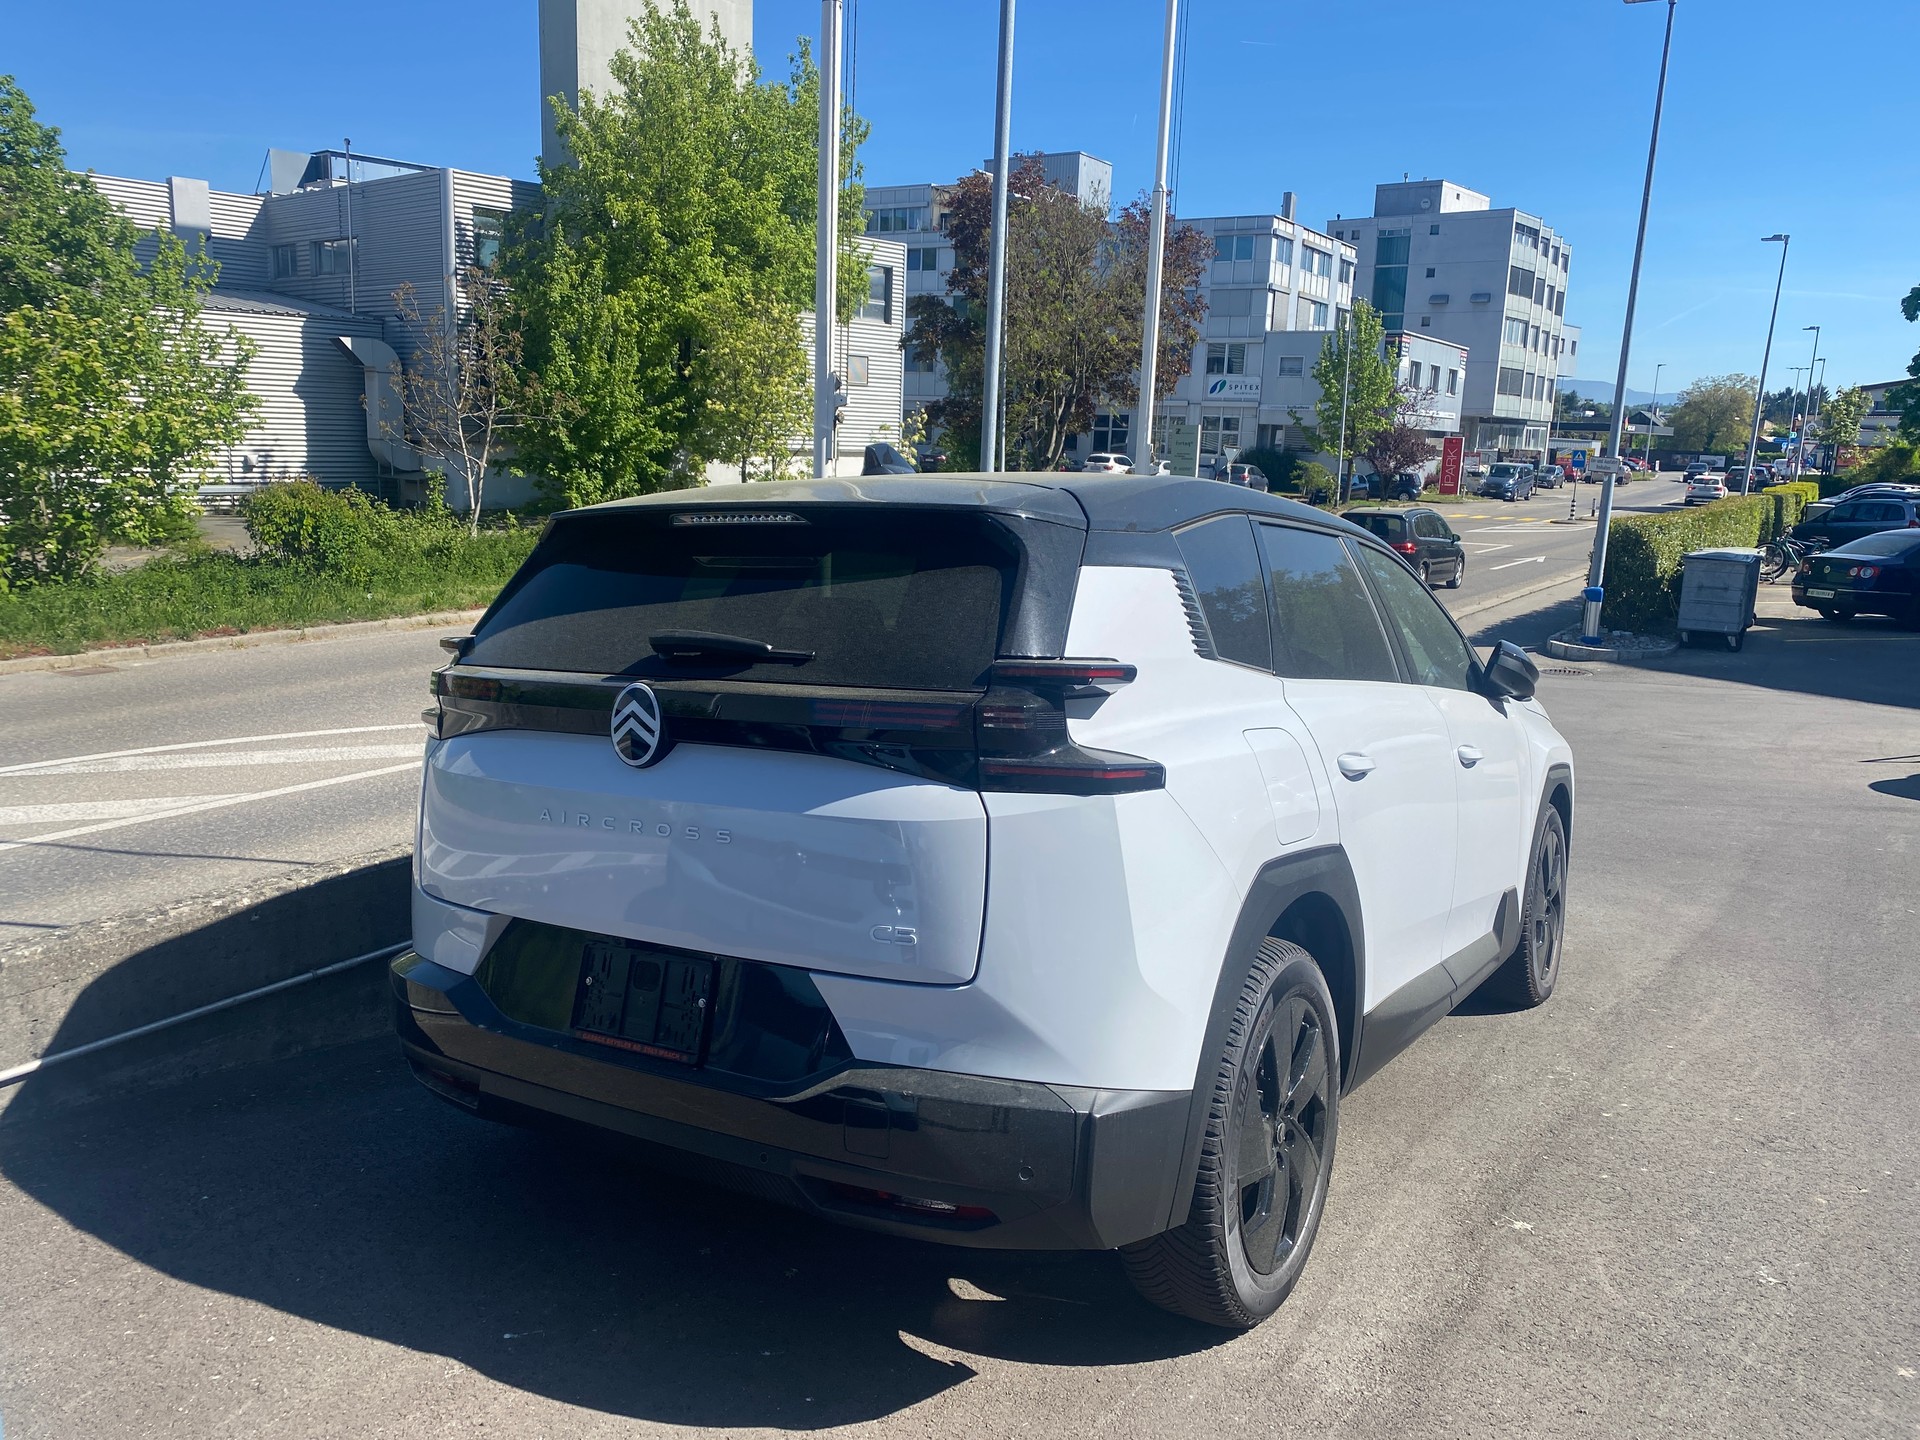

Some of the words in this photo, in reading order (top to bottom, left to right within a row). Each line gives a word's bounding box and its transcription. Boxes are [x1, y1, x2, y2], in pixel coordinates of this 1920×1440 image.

[1441, 448, 1458, 487] iPARK
[539, 807, 732, 845] AIRCROSS
[868, 924, 918, 946] C5
